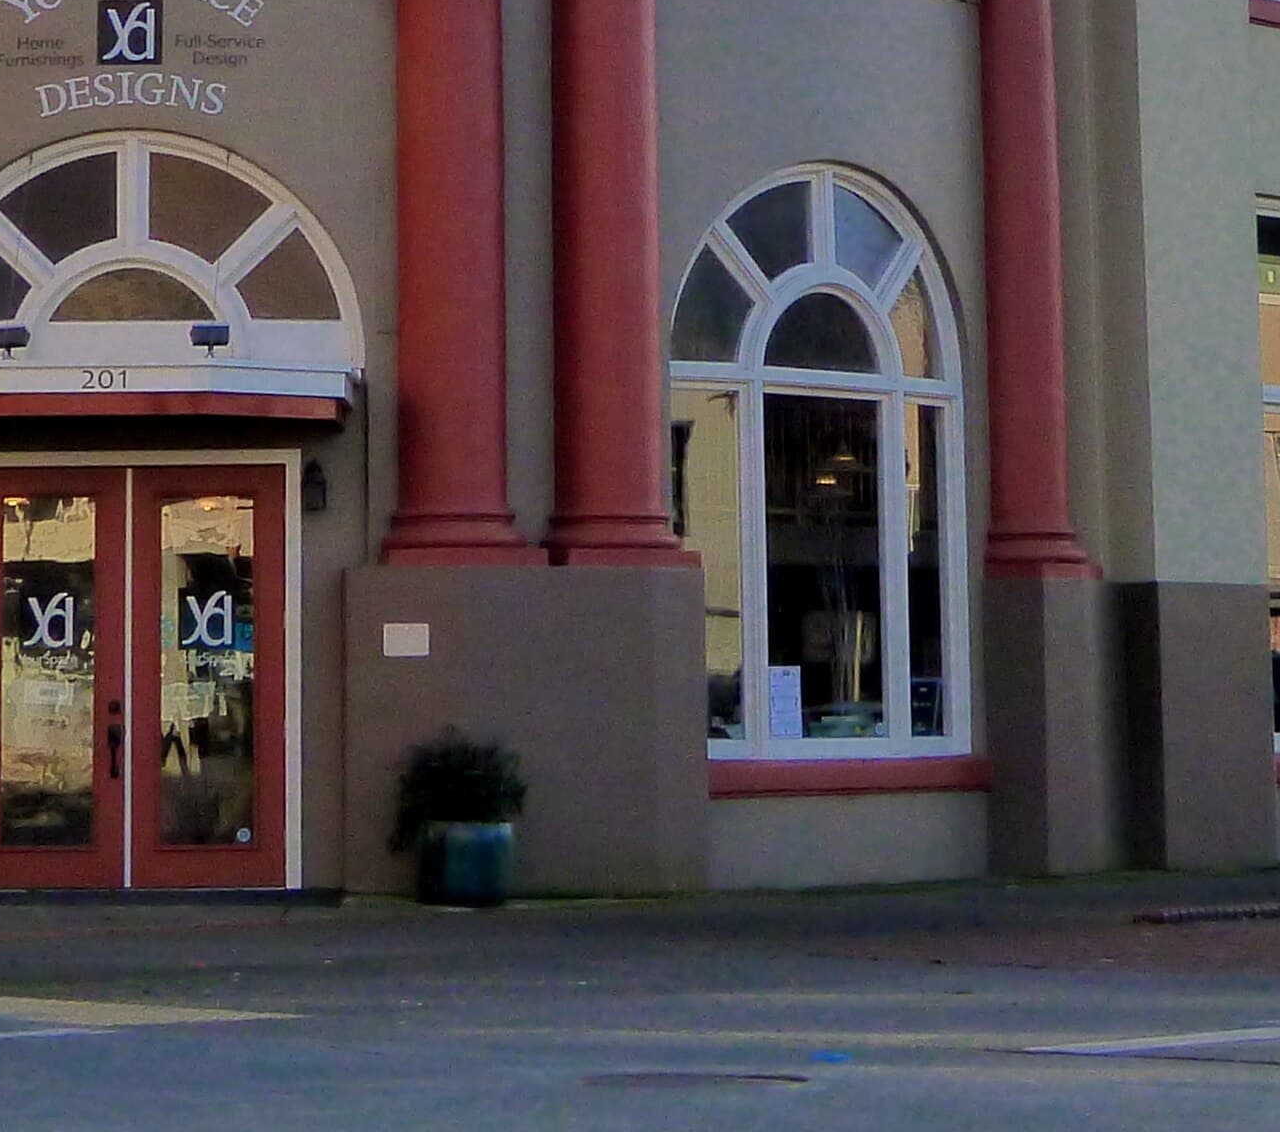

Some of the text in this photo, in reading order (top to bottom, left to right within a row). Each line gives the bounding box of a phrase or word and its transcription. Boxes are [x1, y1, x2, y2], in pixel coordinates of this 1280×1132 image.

[17, 36, 65, 50] Home
[193, 51, 248, 67] Design
[35, 71, 227, 118] DESIGNS
[81, 369, 127, 389] 201
